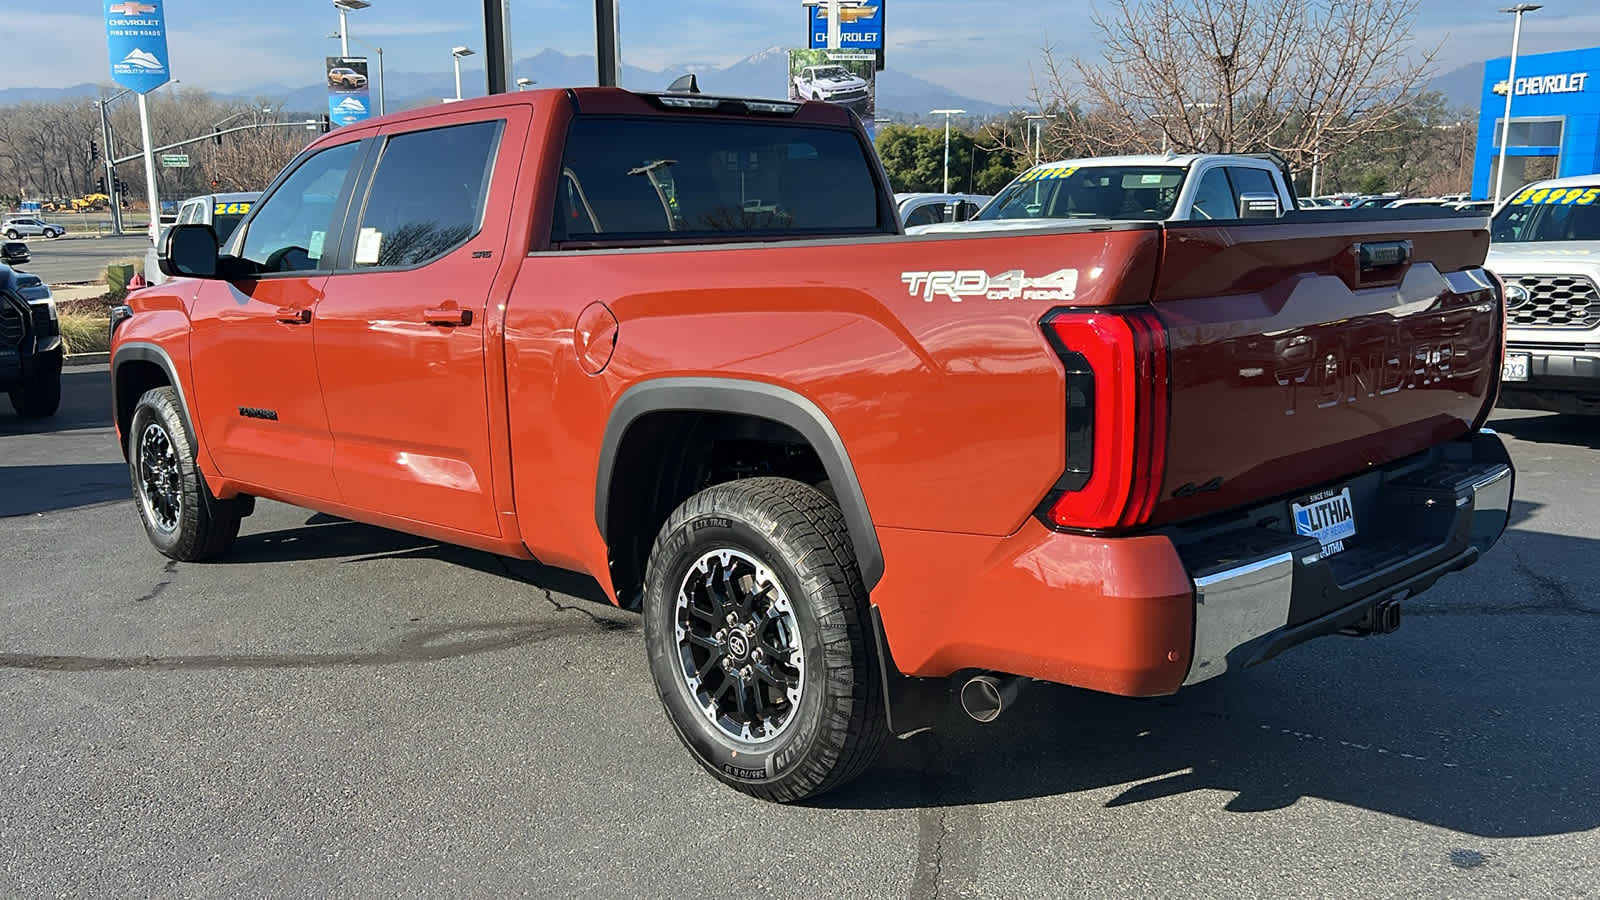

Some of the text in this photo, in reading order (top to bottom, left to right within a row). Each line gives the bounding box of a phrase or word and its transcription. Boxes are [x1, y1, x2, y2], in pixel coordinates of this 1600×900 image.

[815, 32, 878, 42] CHVROLET
[1514, 72, 1588, 95] CHEVROLET
[900, 270, 988, 302] TRD
[1307, 497, 1352, 531] LITHIA
